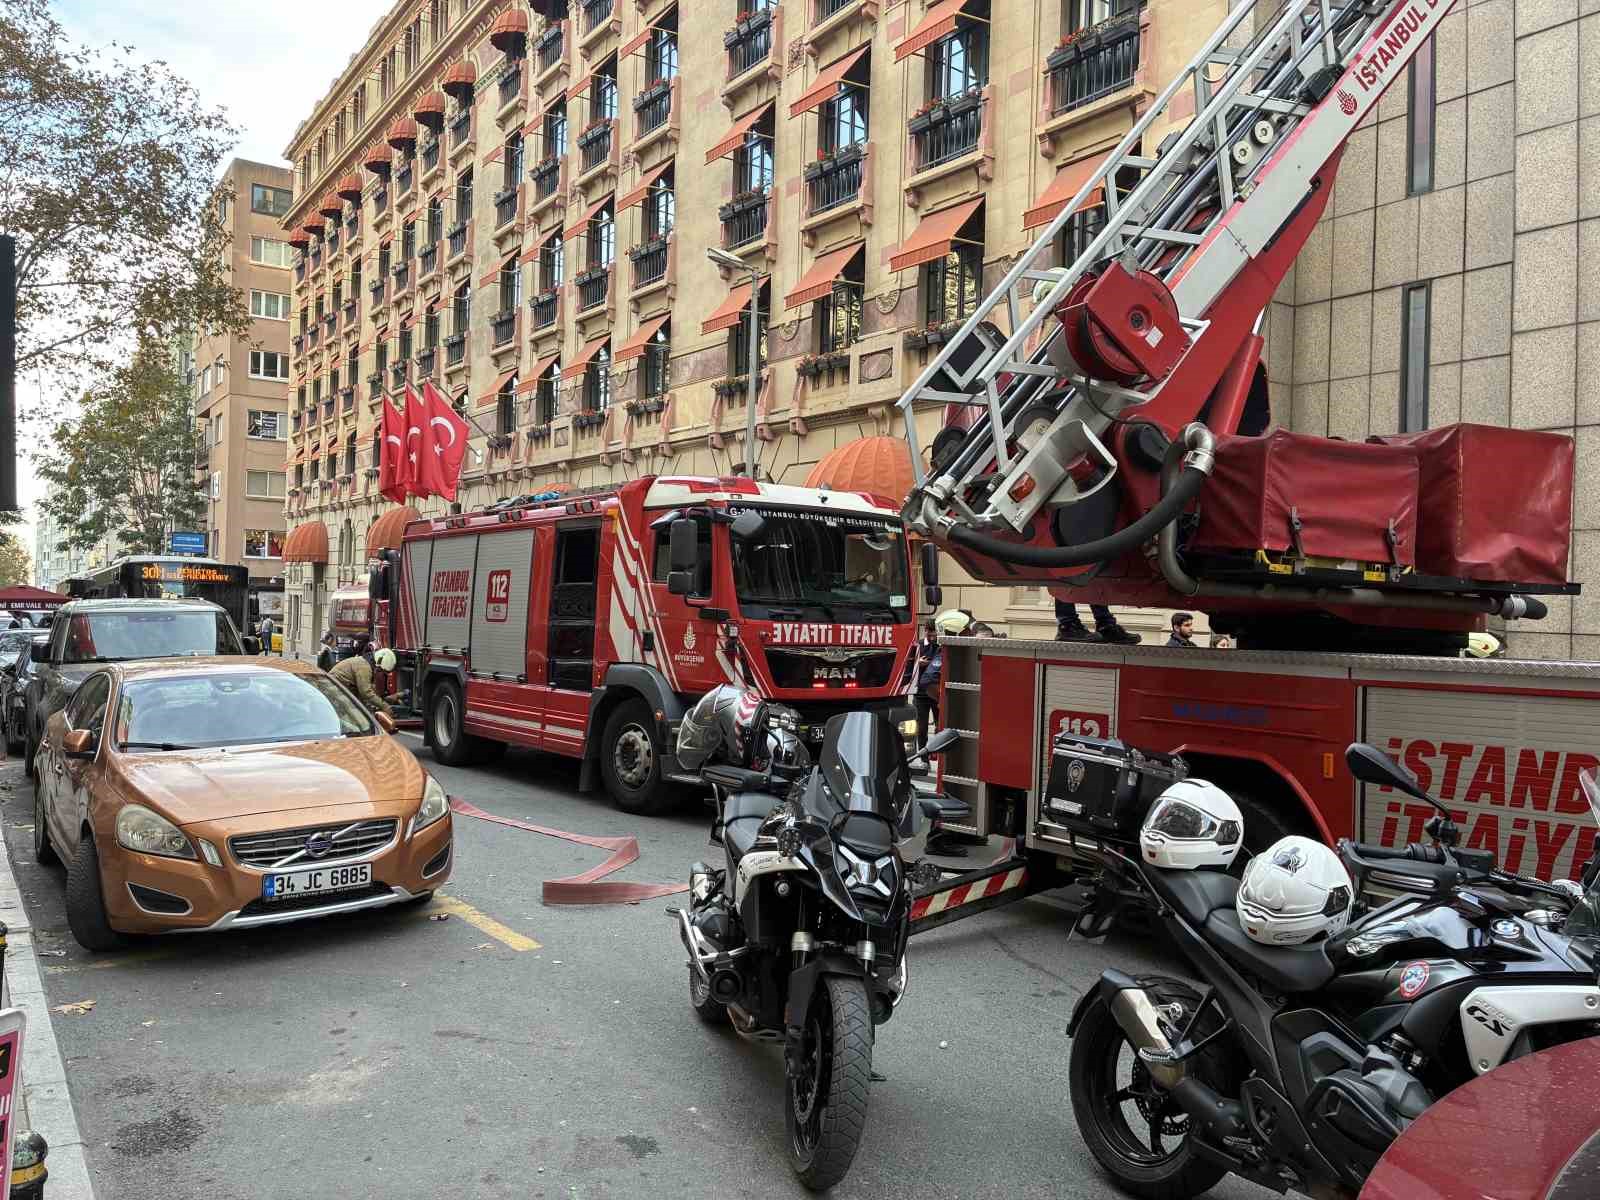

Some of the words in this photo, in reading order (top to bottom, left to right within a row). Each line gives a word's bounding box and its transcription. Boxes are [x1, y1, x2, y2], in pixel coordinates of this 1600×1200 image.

[1352, 5, 1428, 92] İSTANBUL
[432, 570, 470, 593] İSTANBUL
[491, 574, 508, 598] 112
[840, 624, 893, 645] İTFAİYE
[814, 667, 857, 679] MAN
[275, 876, 295, 894] 34
[304, 872, 322, 891] JC
[330, 866, 368, 887] 6885
[1466, 1005, 1513, 1037] GS
